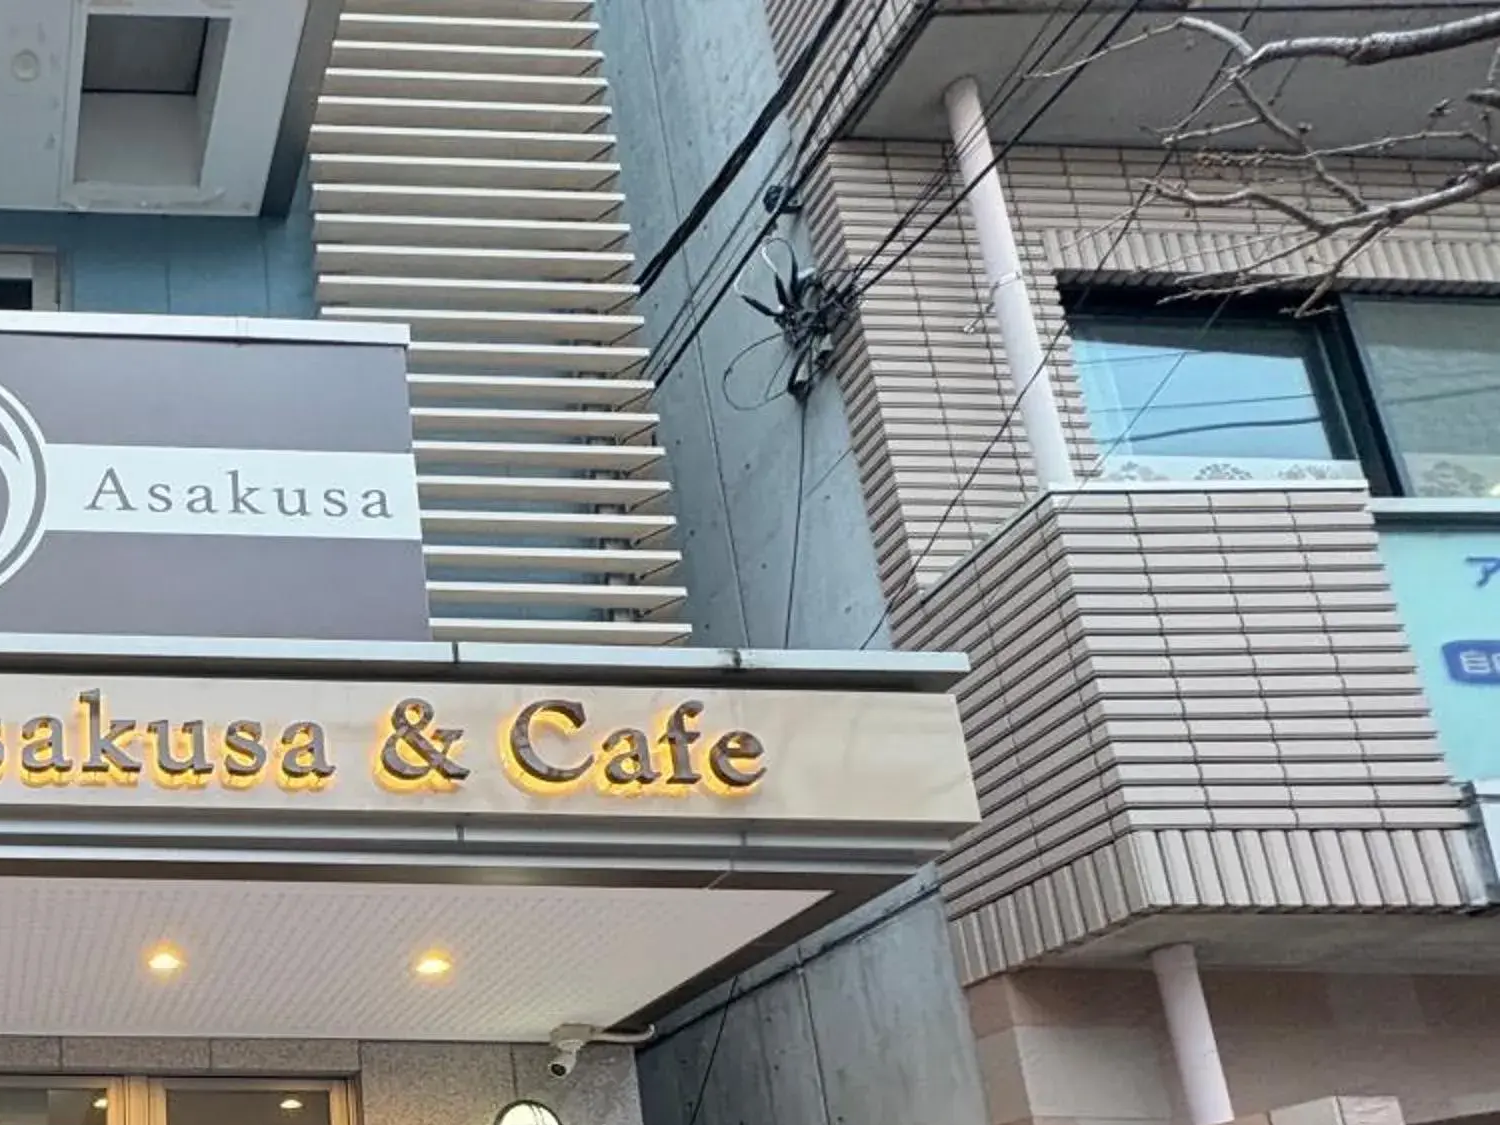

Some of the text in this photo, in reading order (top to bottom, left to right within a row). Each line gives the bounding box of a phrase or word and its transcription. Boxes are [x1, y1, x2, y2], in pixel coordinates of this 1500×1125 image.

[83, 467, 394, 519] Asakusa
[380, 698, 471, 780] &
[508, 698, 768, 787] Cafe
